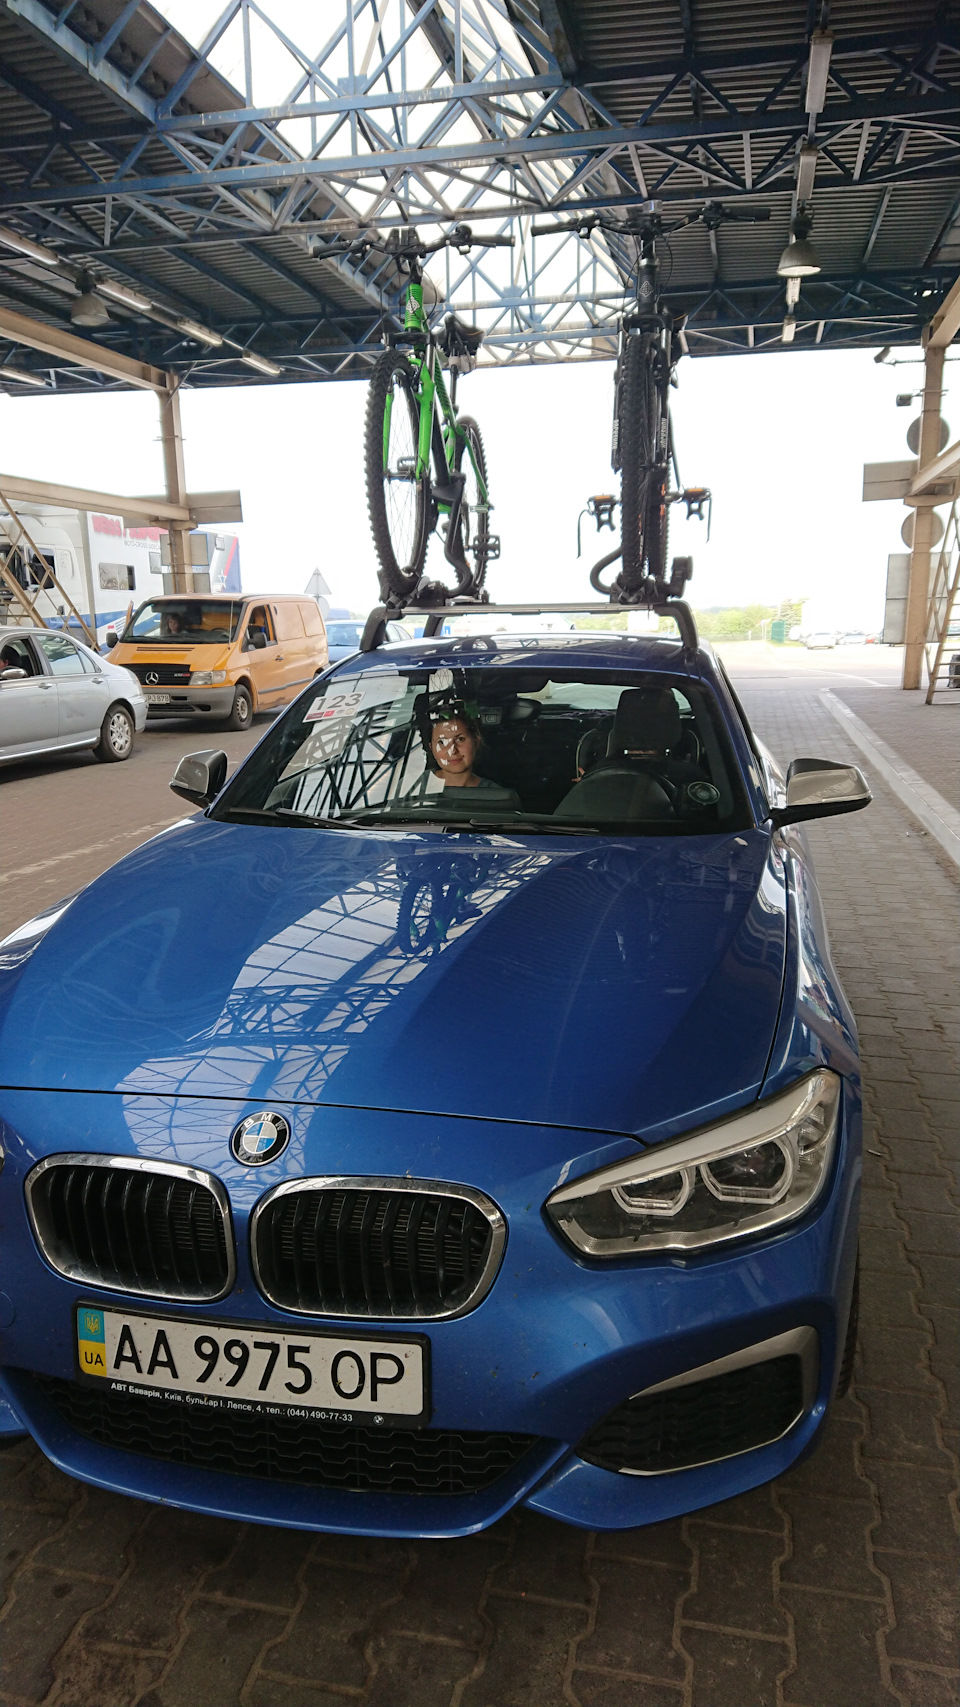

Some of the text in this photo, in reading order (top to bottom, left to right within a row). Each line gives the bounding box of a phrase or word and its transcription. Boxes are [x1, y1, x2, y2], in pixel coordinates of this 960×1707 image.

[316, 693, 362, 711] 123
[243, 1112, 287, 1131] BMW
[84, 1351, 104, 1367] UA
[113, 1324, 405, 1402] AA 9975 OP
[110, 1382, 127, 1392] АВТ
[128, 1385, 162, 1399] Баварія,
[164, 1391, 184, 1402] Київ,
[227, 1401, 255, 1412] Лепсе,
[287, 1407, 309, 1419] (044)
[310, 1411, 353, 1422] 490-77-33
